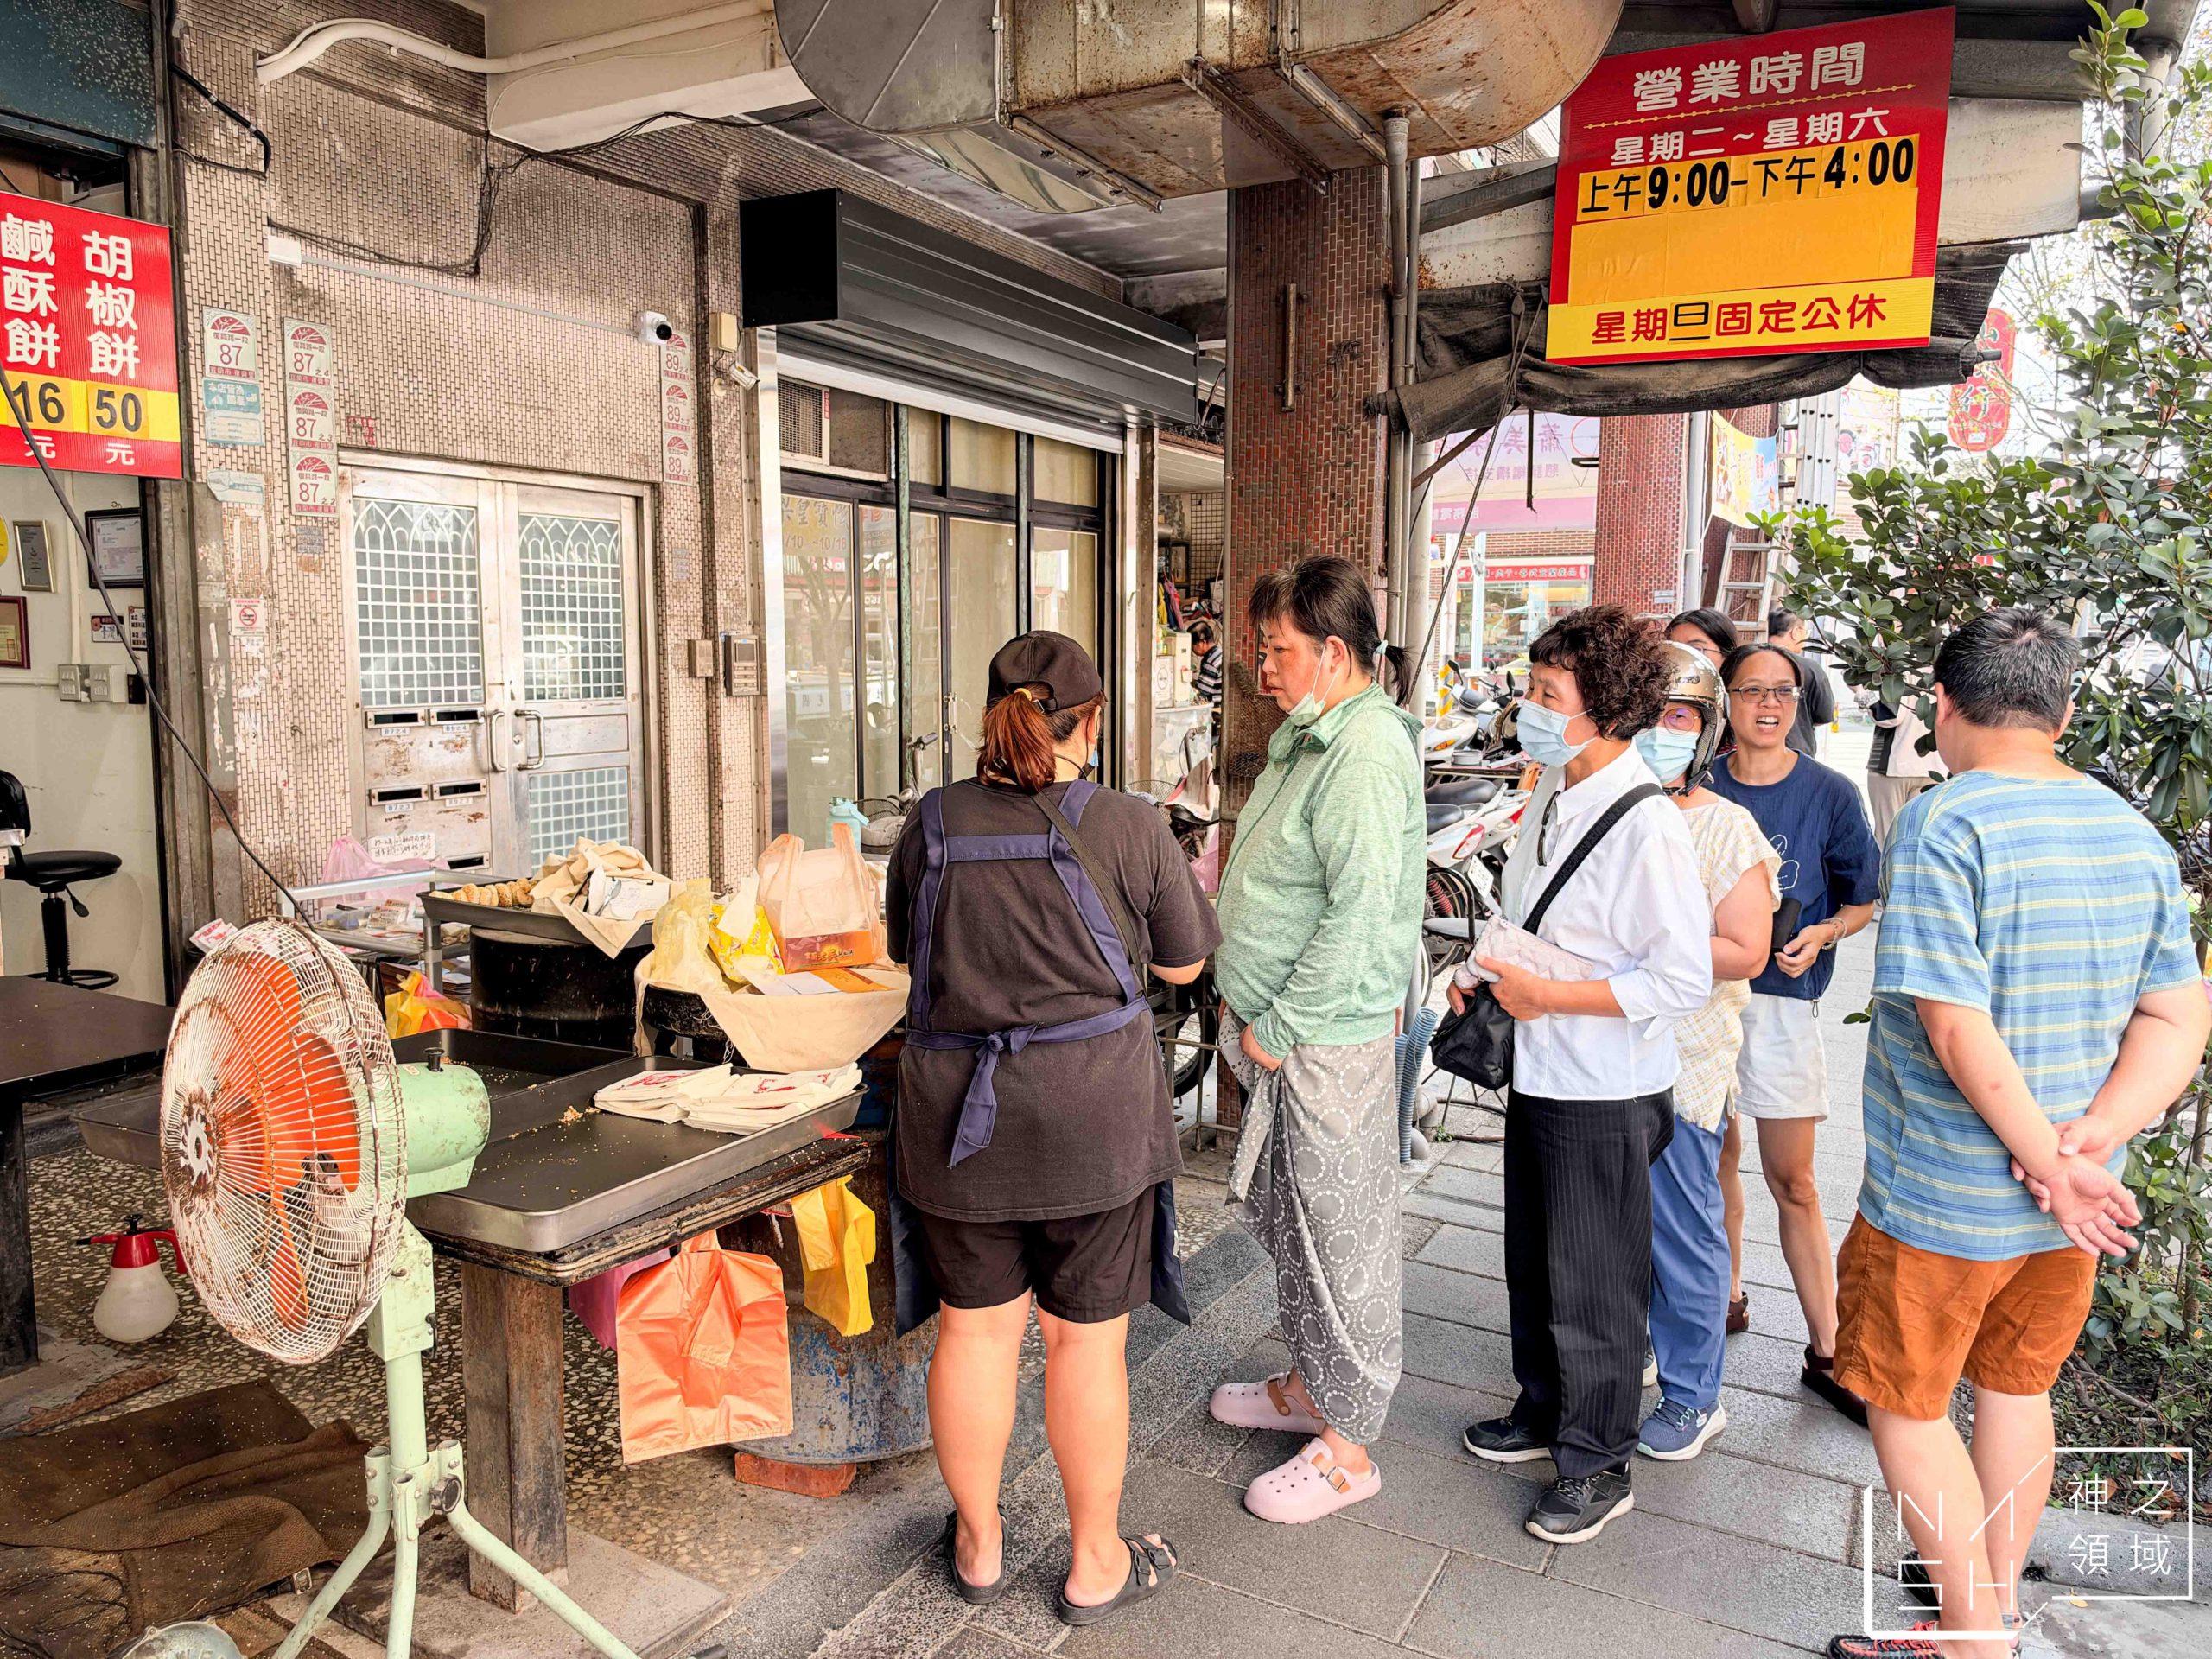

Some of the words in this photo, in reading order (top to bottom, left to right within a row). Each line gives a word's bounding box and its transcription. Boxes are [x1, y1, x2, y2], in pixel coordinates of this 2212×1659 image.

[1633, 41, 1865, 112] 營業時間
[1, 213, 61, 368] 鹹酥餅
[82, 230, 140, 378] 胡椒餅
[219, 344, 242, 366] 87
[13, 380, 65, 424] 16
[95, 389, 143, 432] 50
[24, 435, 56, 459] 元
[105, 442, 135, 465] 元
